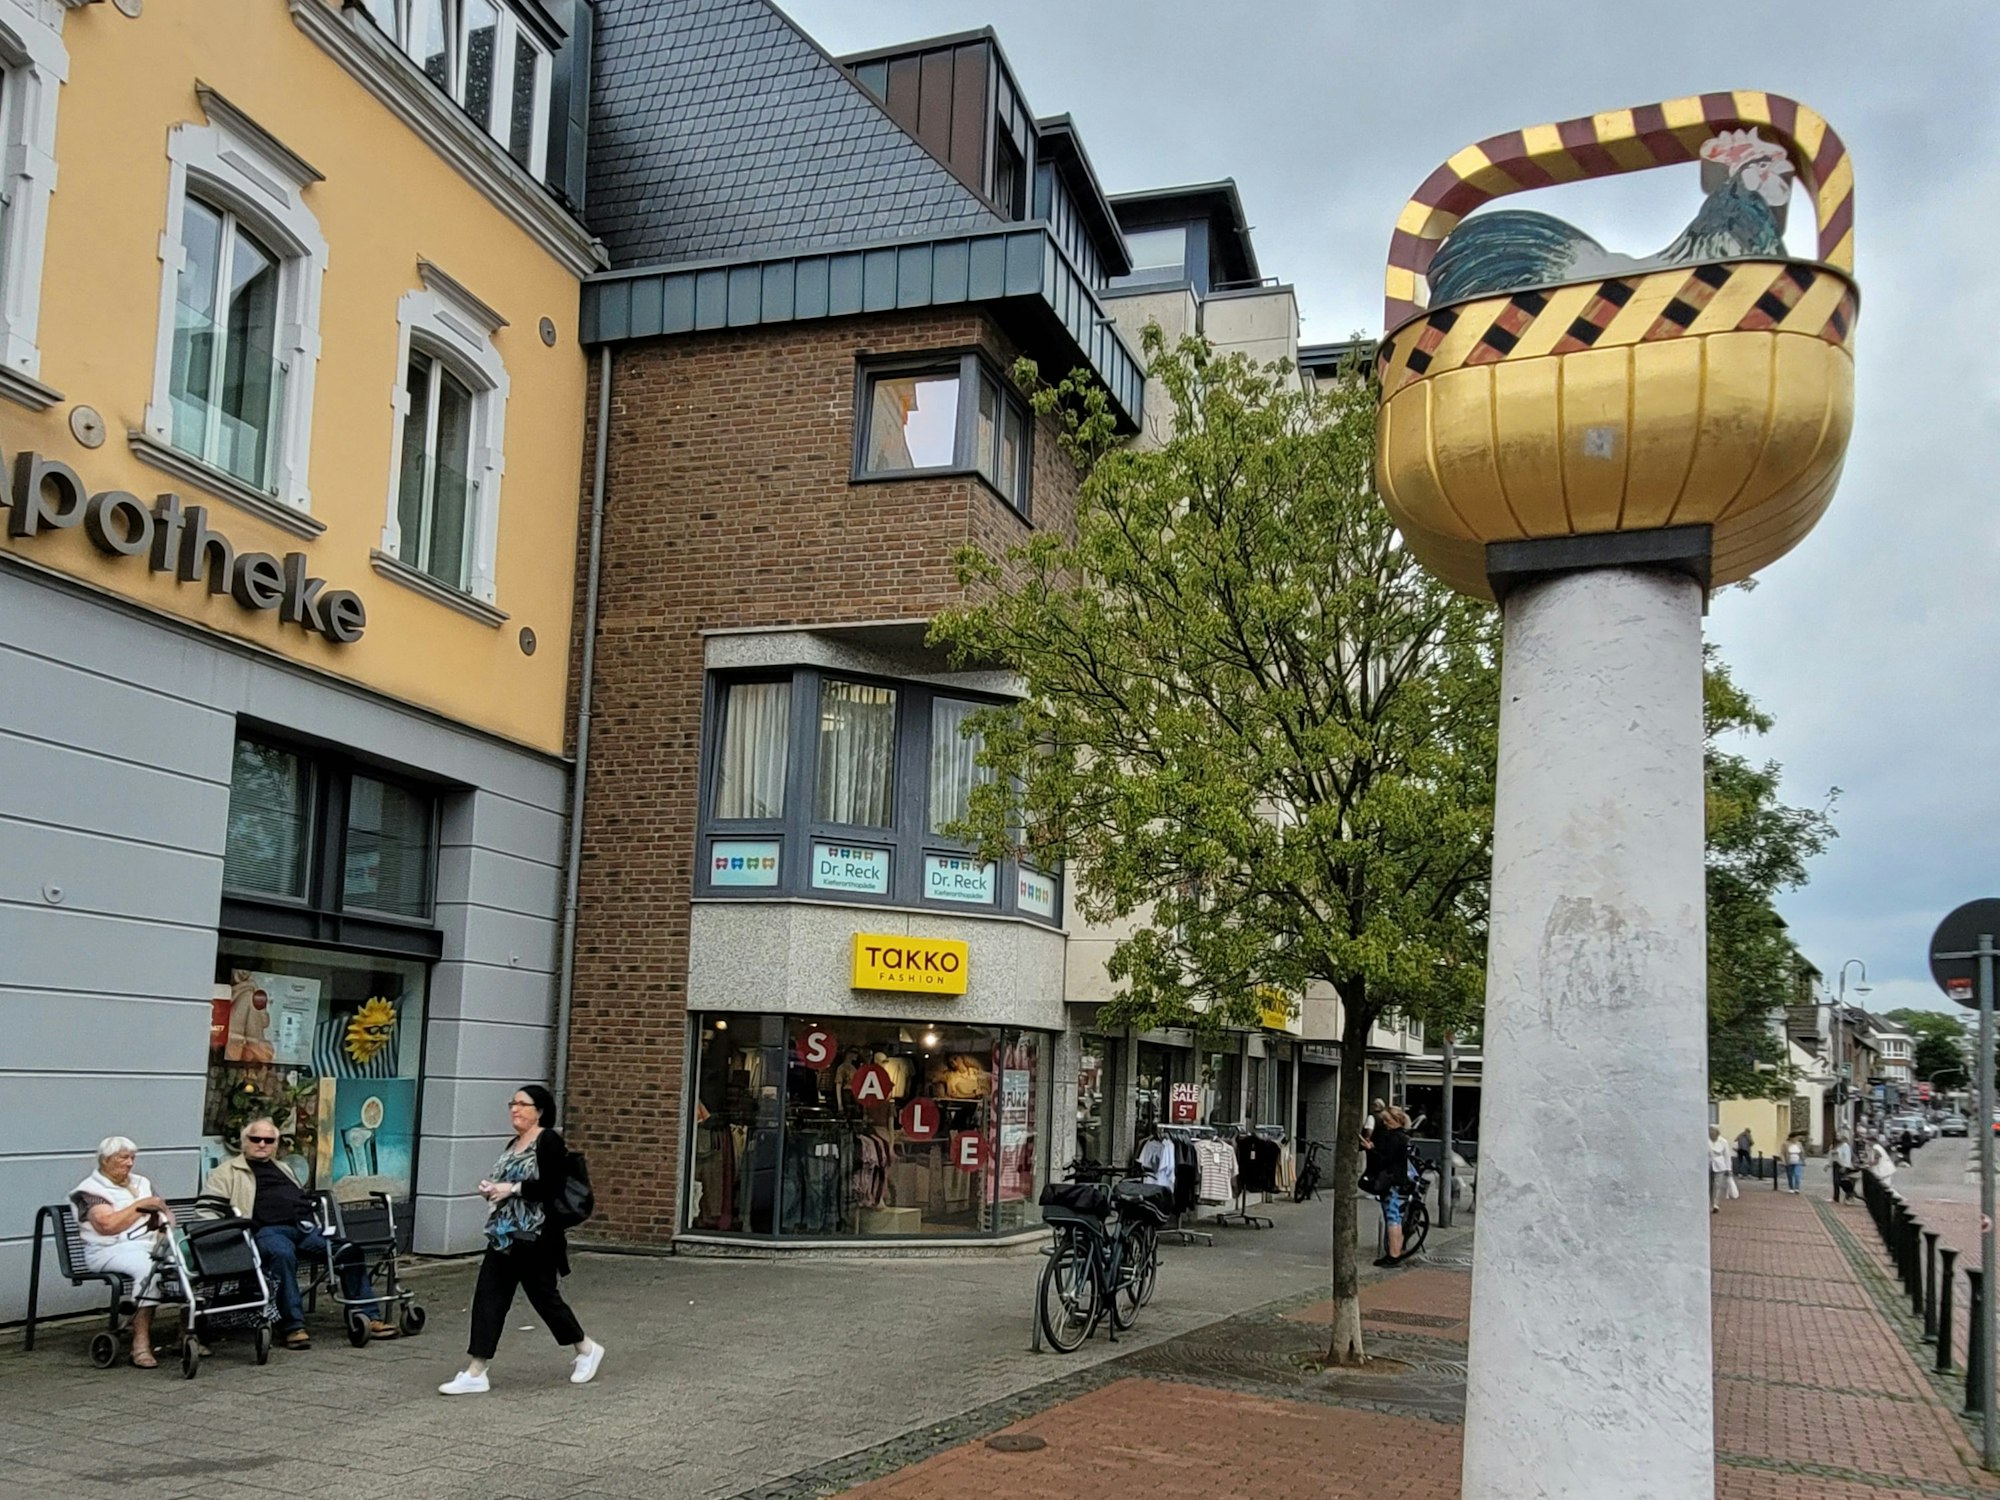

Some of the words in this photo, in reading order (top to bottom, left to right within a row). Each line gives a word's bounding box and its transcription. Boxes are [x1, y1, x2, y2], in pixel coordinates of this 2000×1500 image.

[820, 861, 841, 877] Dr.
[844, 864, 880, 881] Reck
[823, 878, 876, 890] Kieferorthopädie
[931, 872, 951, 887] Dr.
[954, 874, 987, 891] Reck
[934, 889, 984, 900] Kieferorthopädie
[879, 972, 944, 985] FASHION
[1173, 1083, 1199, 1093] SALE
[1172, 1092, 1198, 1102] SALE
